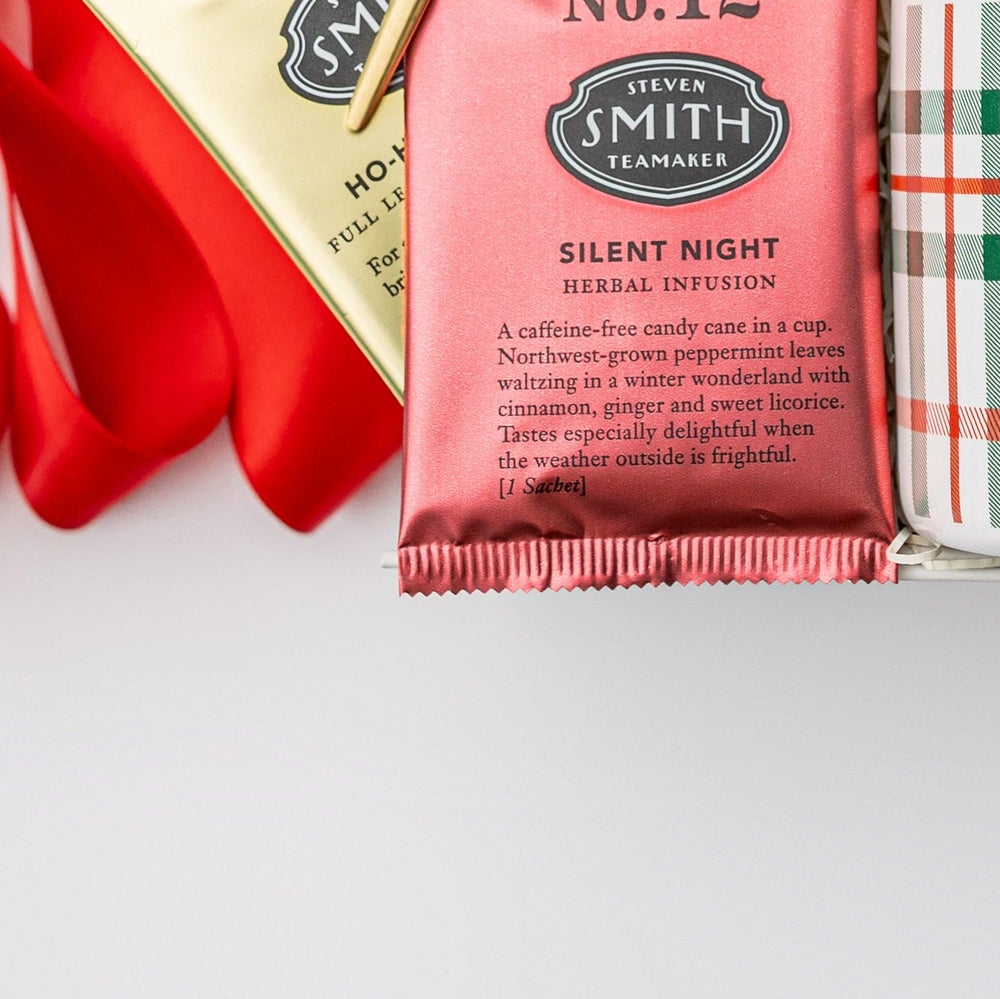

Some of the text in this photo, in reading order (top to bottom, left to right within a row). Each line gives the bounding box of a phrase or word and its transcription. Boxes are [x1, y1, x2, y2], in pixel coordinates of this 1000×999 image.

[627, 77, 706, 95] STEVEN
[581, 102, 750, 147] SMITH
[607, 152, 728, 170] TEAMAKER
[327, 210, 380, 254] FULL
[366, 247, 400, 277] For
[559, 237, 779, 264] SILENT NIGHT
[563, 274, 777, 294] HERBAL INFUSION
[497, 316, 832, 341] A caffeine-free candy cane in a cup.
[497, 340, 845, 368] Northwest-grown peppermint leaves
[497, 365, 850, 395] waltzing in a winter wonderland with
[498, 392, 845, 420] cinnamon, ginger and sweet licorice.
[497, 418, 815, 446] Tastes especially delightful when
[498, 444, 797, 469] the weather outside is frightful.
[499, 475, 586, 500] [1 Sachet]
